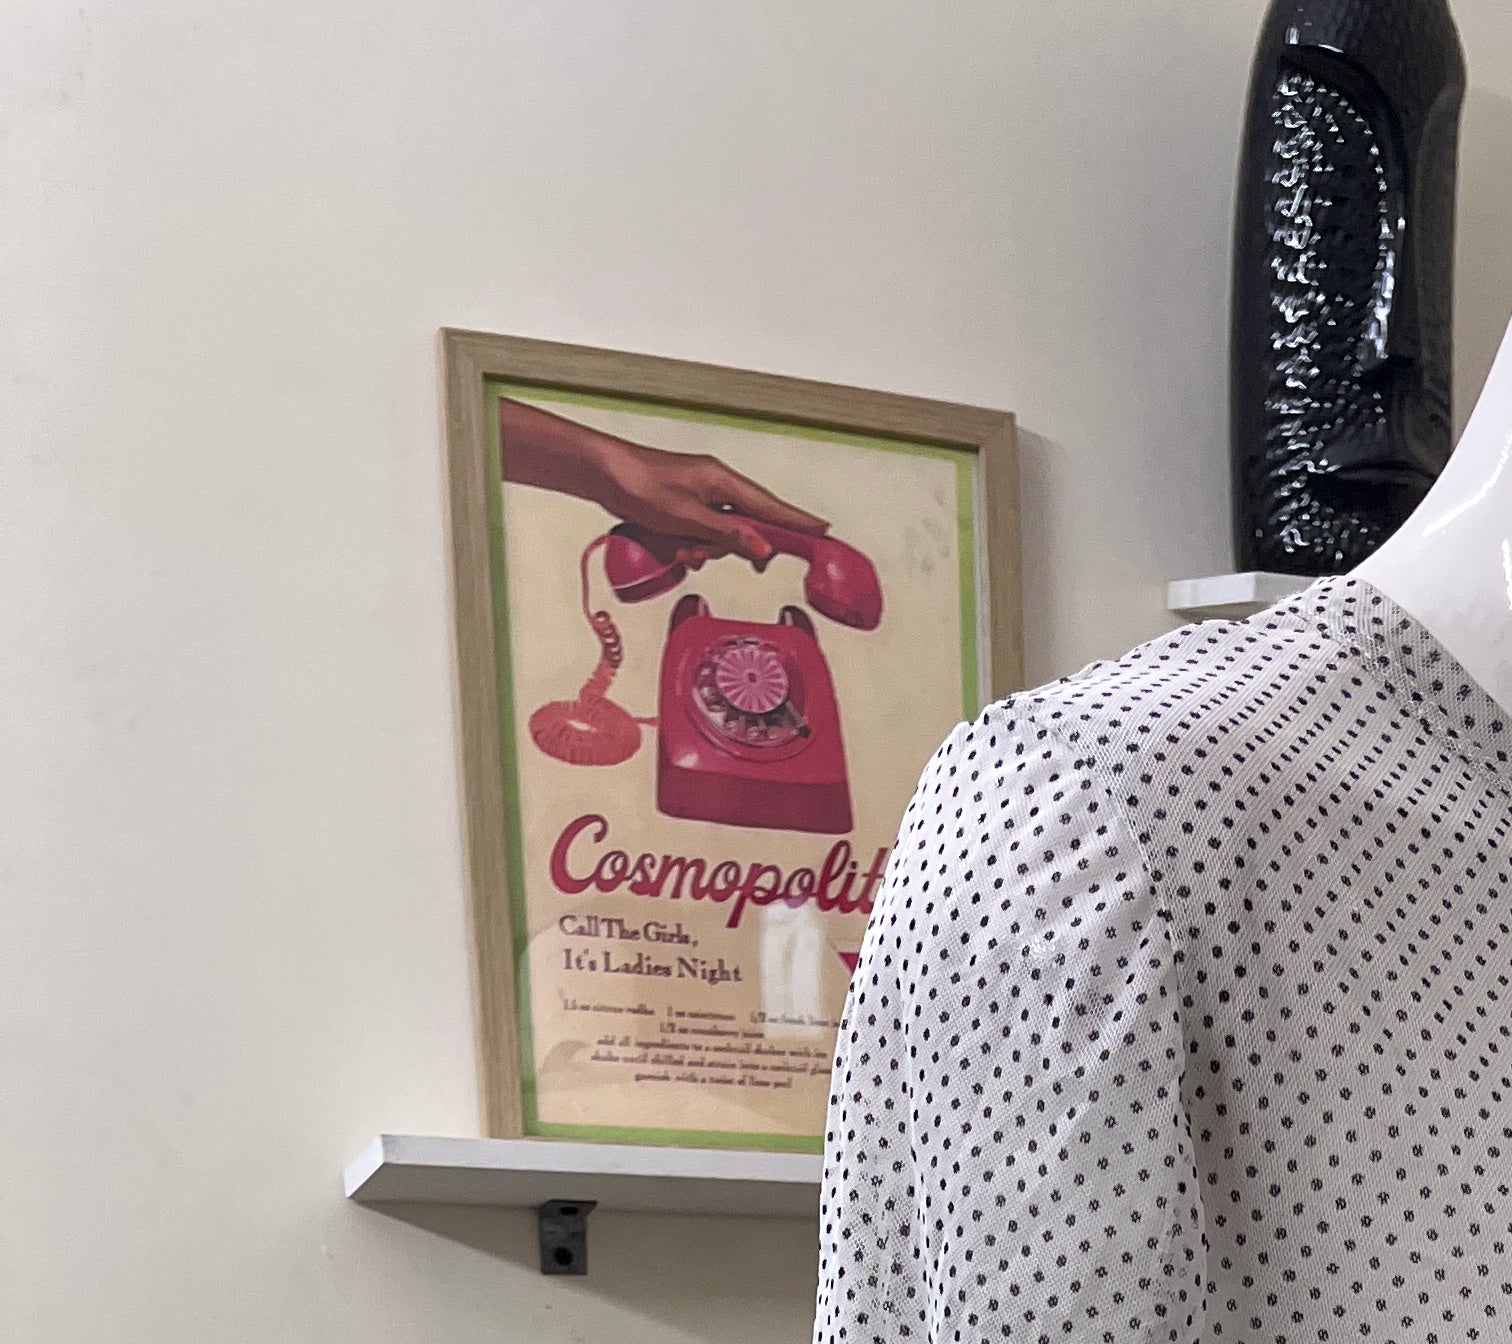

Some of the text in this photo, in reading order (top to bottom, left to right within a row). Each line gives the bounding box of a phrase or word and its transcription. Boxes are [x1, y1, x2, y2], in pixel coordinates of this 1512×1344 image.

[559, 914, 698, 947] Call The Girls,
[563, 948, 742, 985] It's Ladies Night
